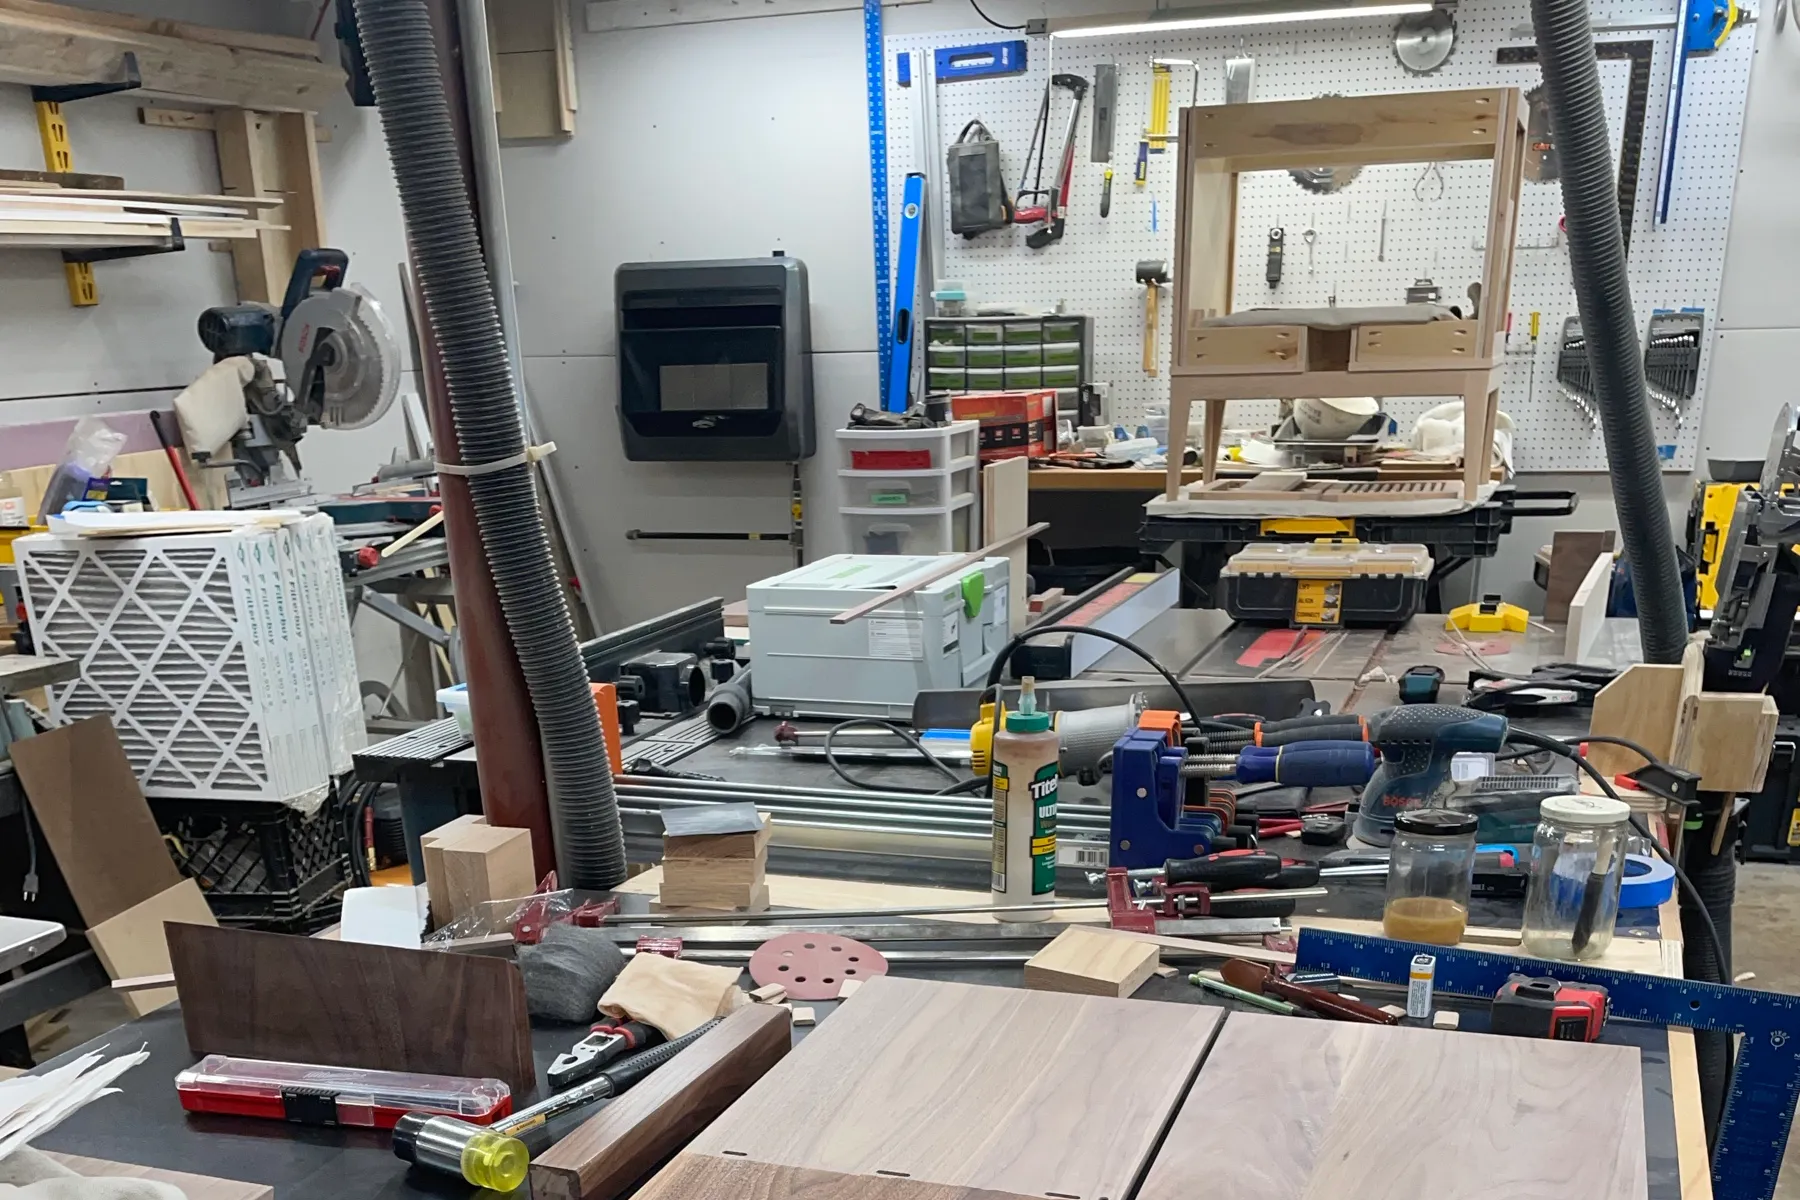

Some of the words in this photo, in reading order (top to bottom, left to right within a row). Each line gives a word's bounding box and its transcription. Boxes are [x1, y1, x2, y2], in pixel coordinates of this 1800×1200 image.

[245, 588, 259, 646] Filterbuy
[261, 587, 275, 645] Filterbuy
[275, 584, 288, 641] Filterbuy
[289, 581, 302, 638] Filterbuy
